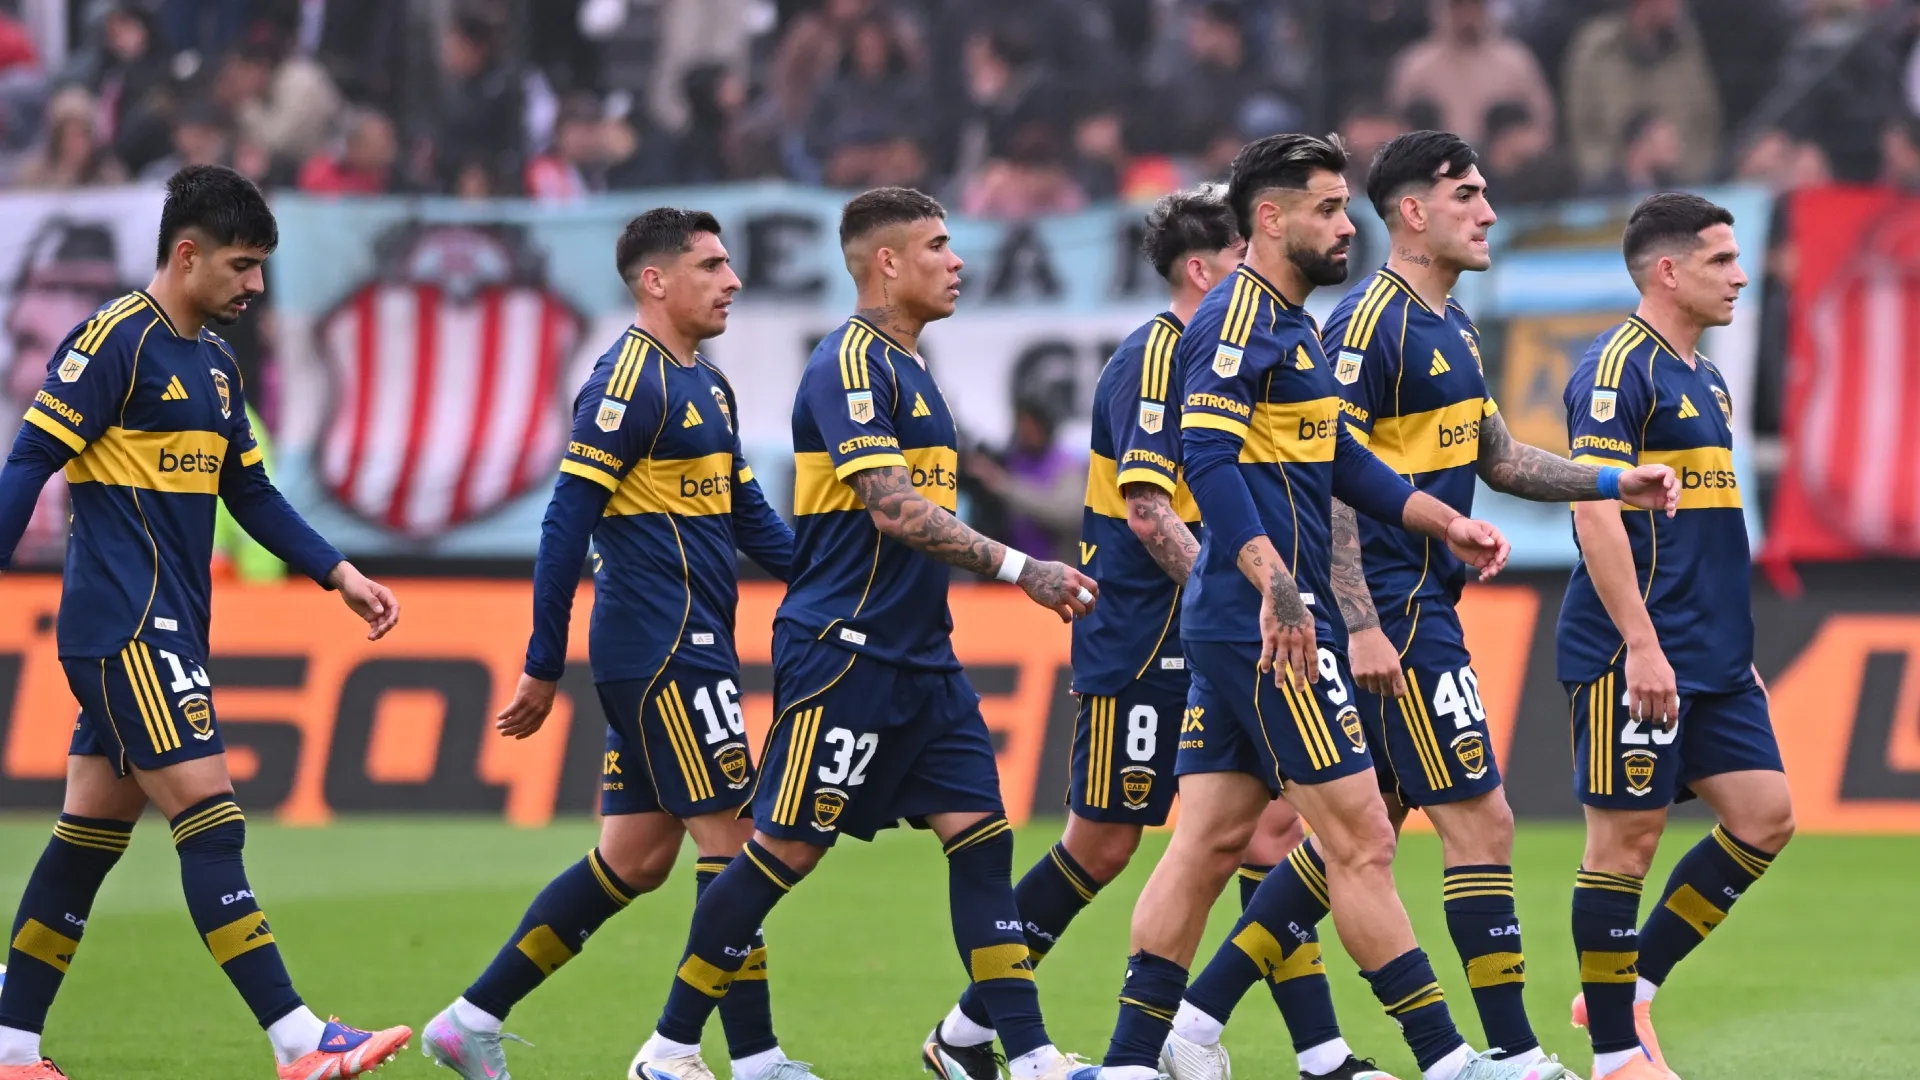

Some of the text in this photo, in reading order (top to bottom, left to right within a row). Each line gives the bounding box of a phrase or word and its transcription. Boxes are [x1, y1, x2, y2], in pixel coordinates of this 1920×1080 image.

[36, 390, 84, 427] ETROGAR
[1187, 392, 1250, 418] CETROGAR
[1337, 398, 1369, 424] OGAR
[568, 441, 624, 472] CETROGAR
[839, 436, 900, 454] CETROGAR
[1573, 435, 1633, 455] CETROGAR
[1121, 448, 1176, 473] CETROGAR
[1317, 647, 1348, 705] 9
[1433, 665, 1486, 729] 40
[693, 679, 745, 745] 16
[1126, 704, 1158, 761] 8
[725, 760, 744, 771] CABJ
[818, 726, 879, 786] 32
[1462, 750, 1481, 760] CABJ
[1127, 783, 1147, 791] CABJ
[818, 805, 839, 814] CABJ
[220, 889, 255, 906] CA
[995, 920, 1024, 932] CA
[1288, 921, 1312, 944] CA
[1489, 924, 1521, 937] CA
[724, 944, 752, 958] CA
